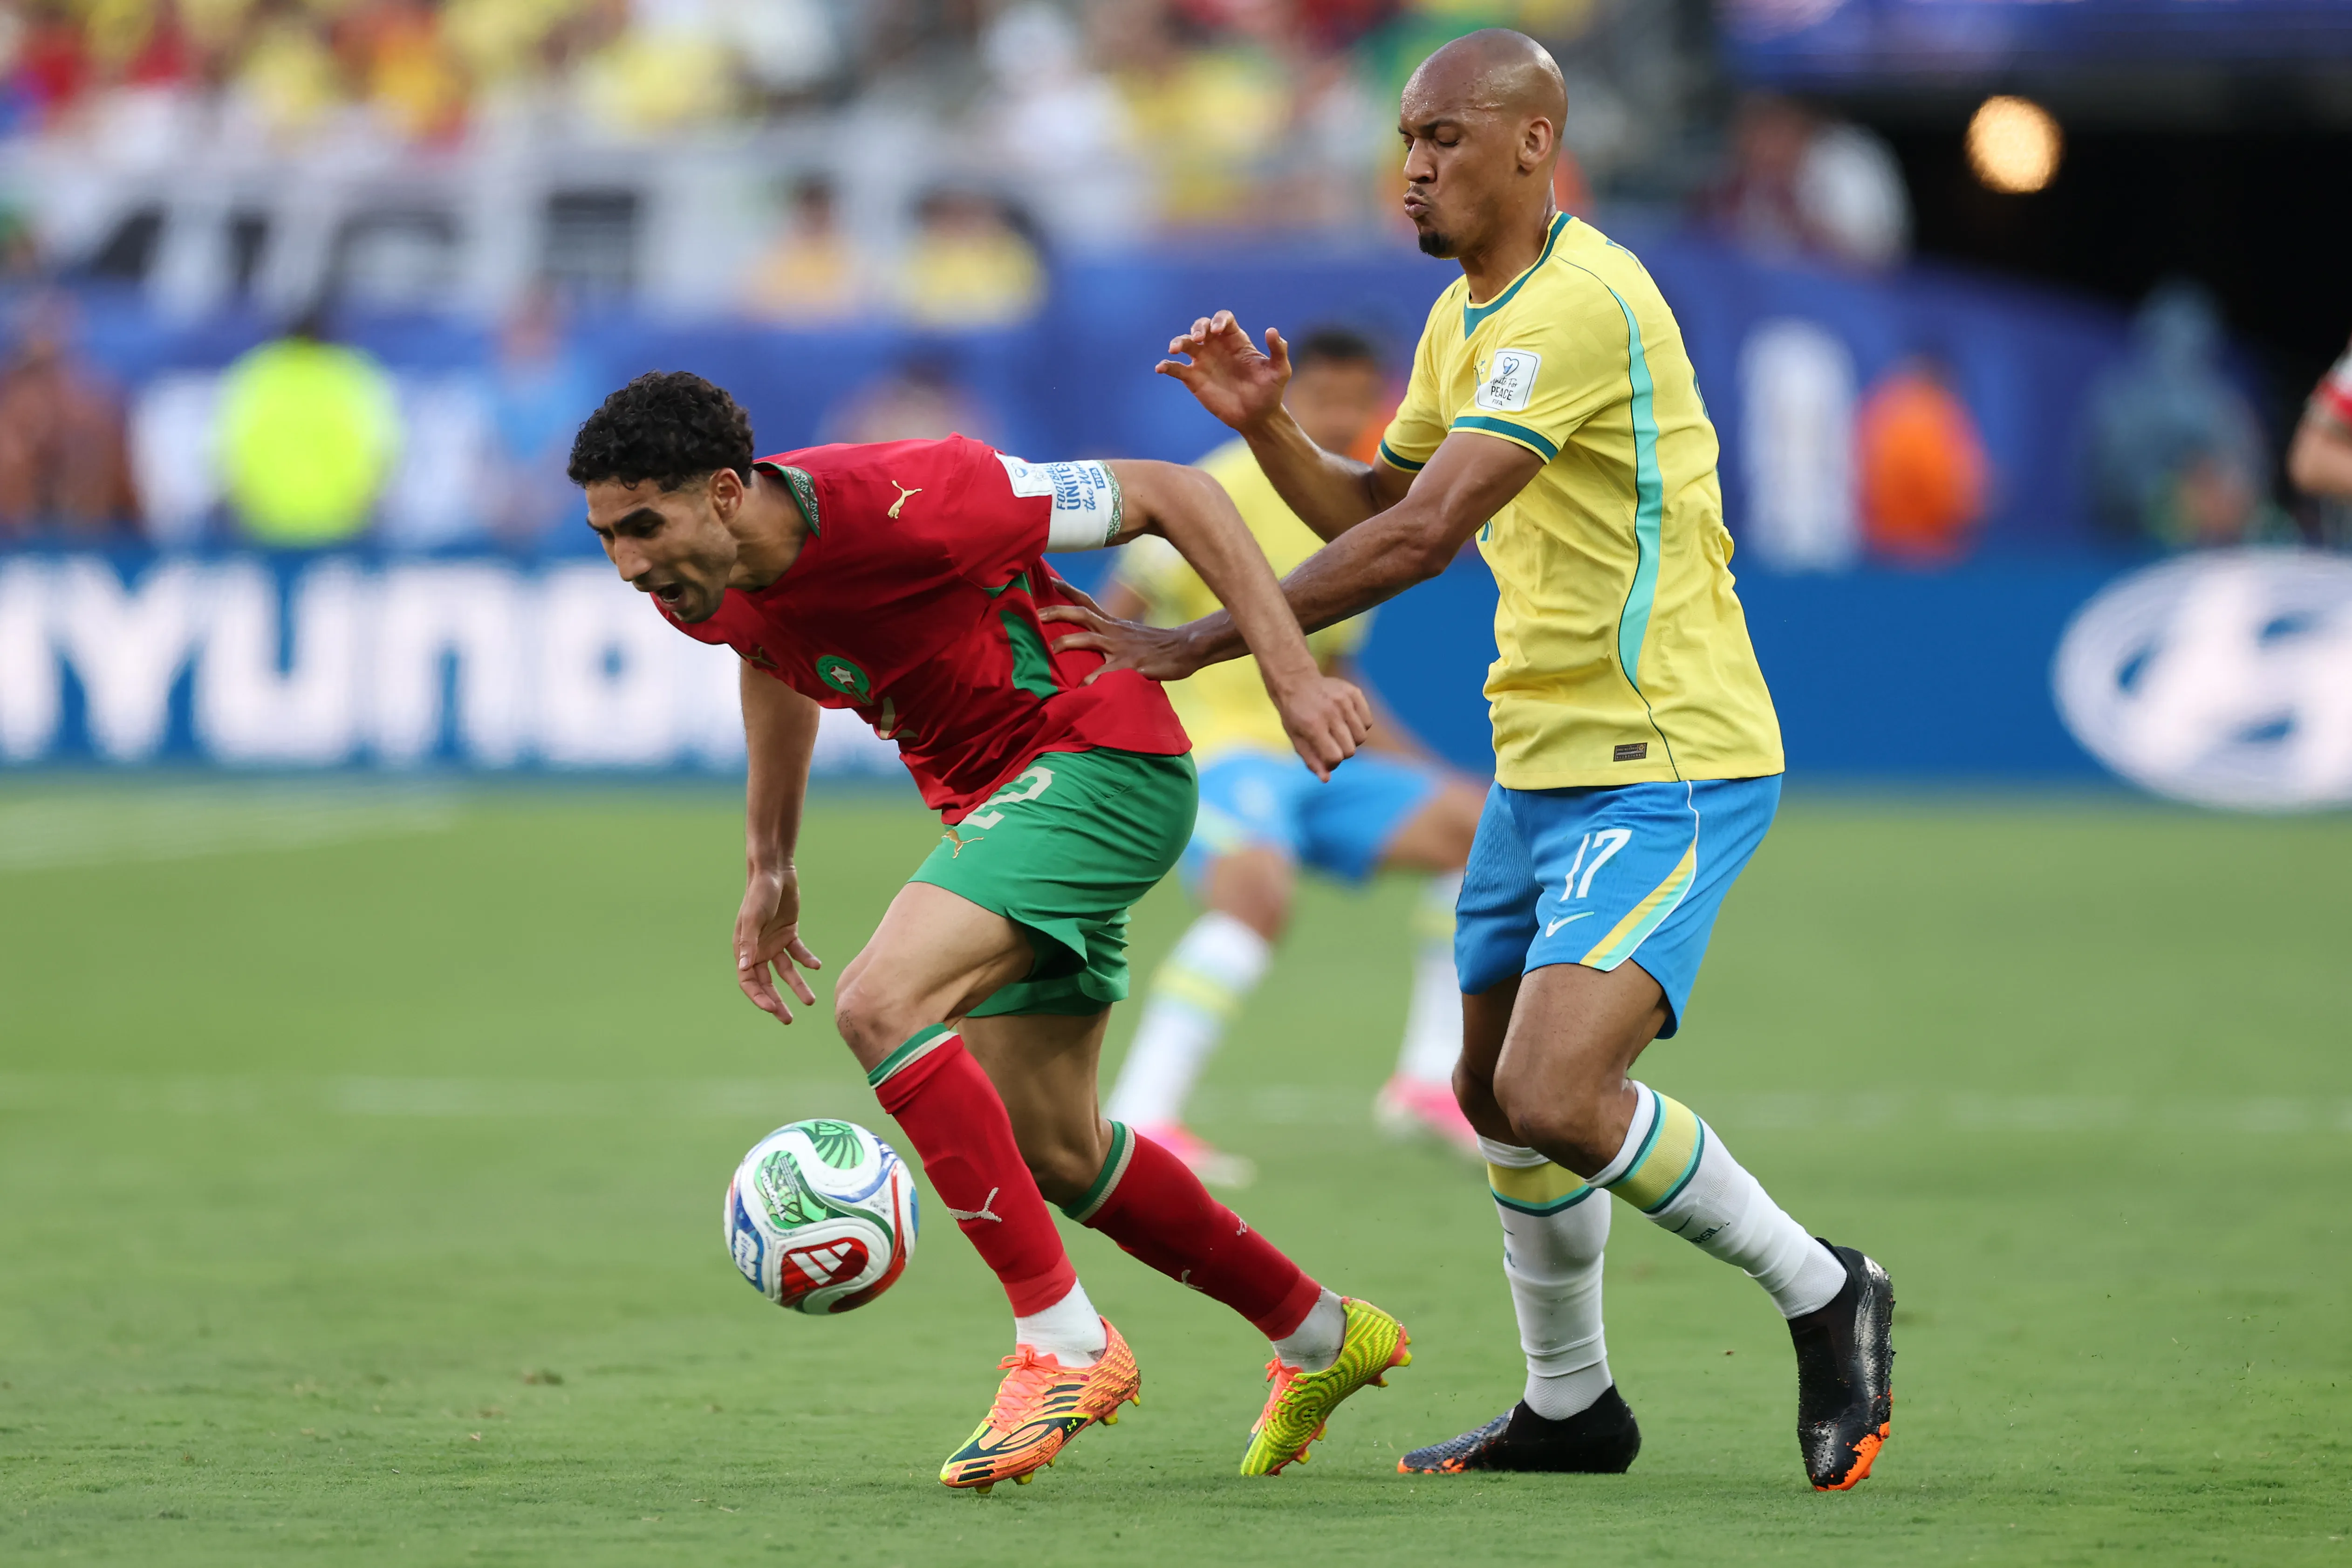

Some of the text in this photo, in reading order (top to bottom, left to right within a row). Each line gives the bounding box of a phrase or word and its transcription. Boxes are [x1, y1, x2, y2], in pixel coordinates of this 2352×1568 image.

[1491, 385, 1513, 401] PEACE
[1508, 377, 1518, 388] For
[1051, 463, 1081, 510] UNITES
[1091, 468, 1104, 487] FIFA
[1082, 487, 1096, 513] the
[957, 766, 1056, 830] 2
[1559, 828, 1633, 903] 17
[760, 1167, 787, 1221] TRIONDA
